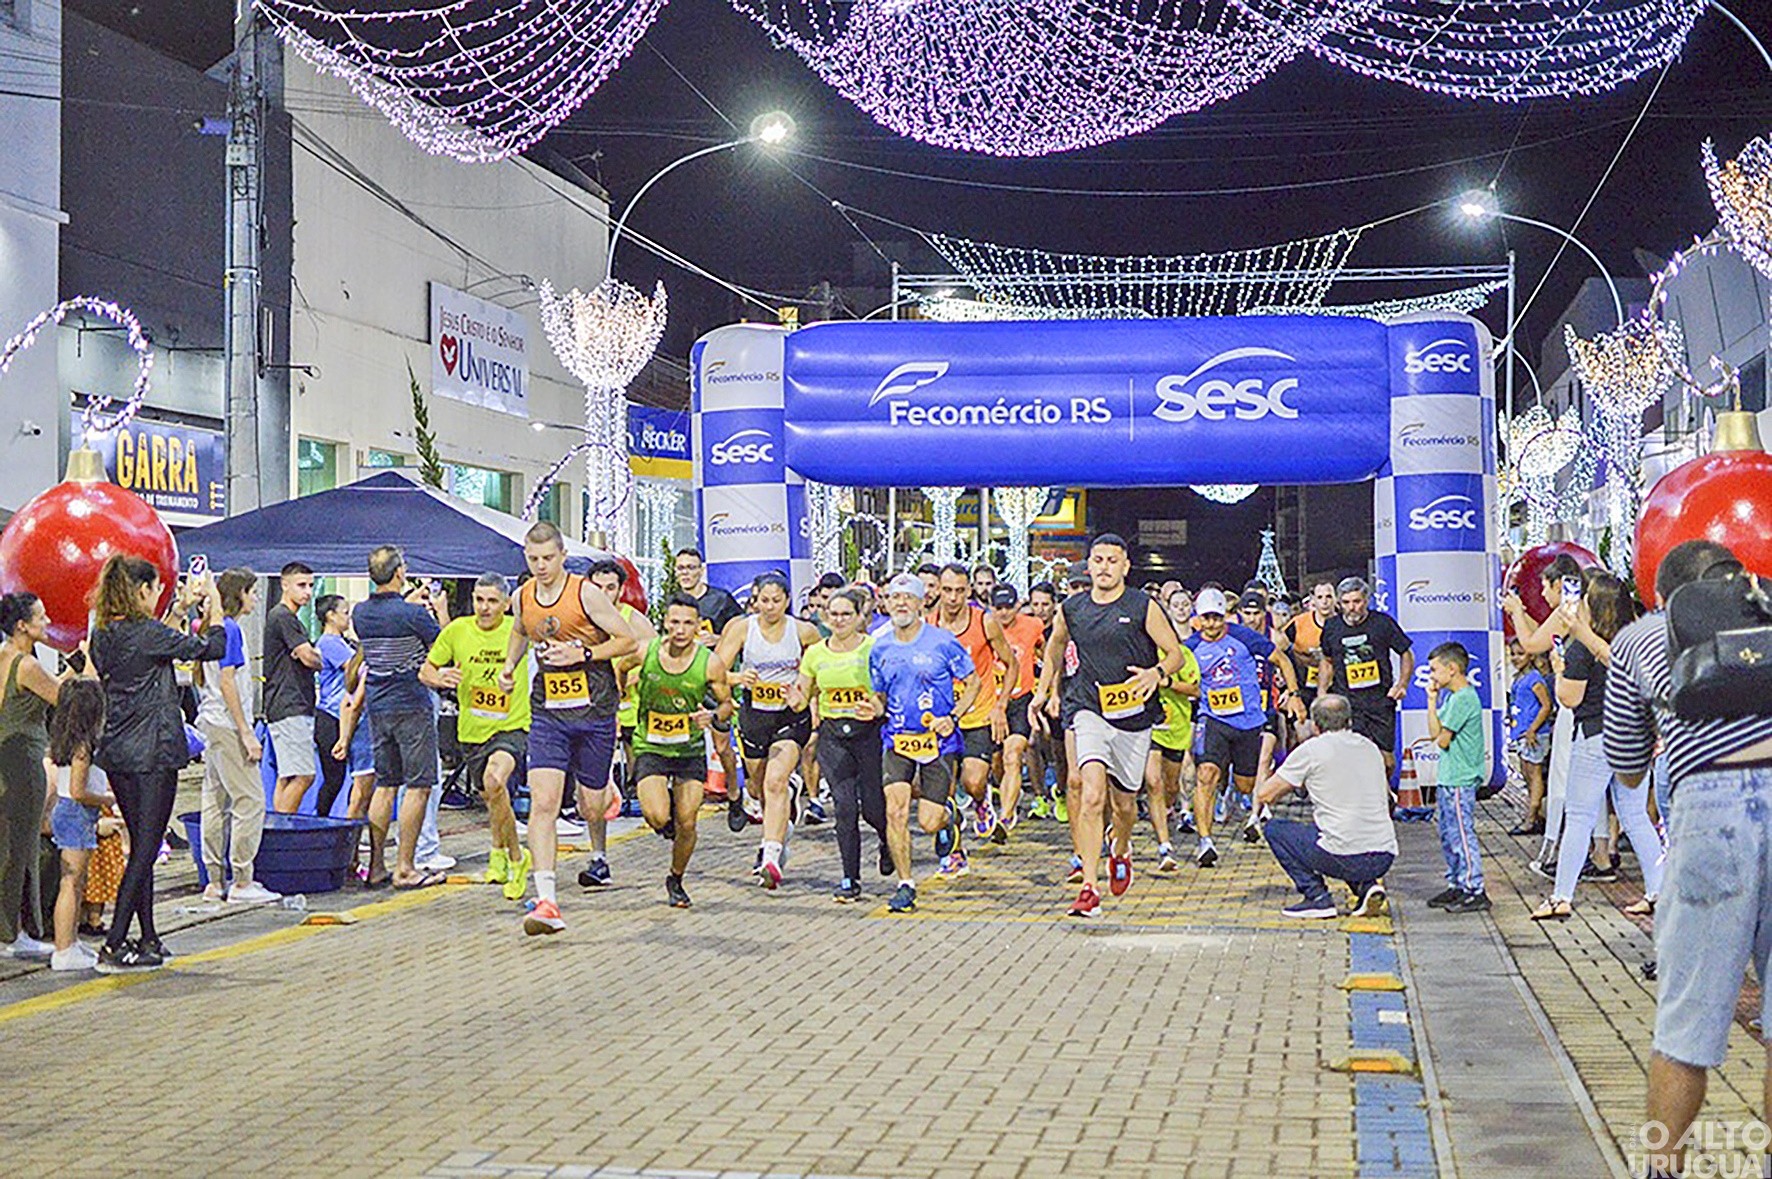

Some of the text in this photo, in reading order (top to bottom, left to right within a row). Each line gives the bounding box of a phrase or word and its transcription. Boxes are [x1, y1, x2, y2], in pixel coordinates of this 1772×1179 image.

[707, 371, 780, 384] Fecomércio RS
[890, 397, 1111, 426] Fecomércio RS
[1403, 435, 1466, 447] Fecomércio
[117, 429, 199, 494] GARRA
[712, 525, 769, 536] Fecomércio
[770, 523, 786, 534] RS
[1409, 592, 1472, 603] Fecomércio
[1349, 665, 1375, 679] 377
[549, 677, 583, 695] 355
[475, 691, 506, 707] 381
[832, 690, 865, 703] 418
[1211, 691, 1239, 706] 376
[653, 718, 685, 732] 254
[900, 738, 933, 752] 294
